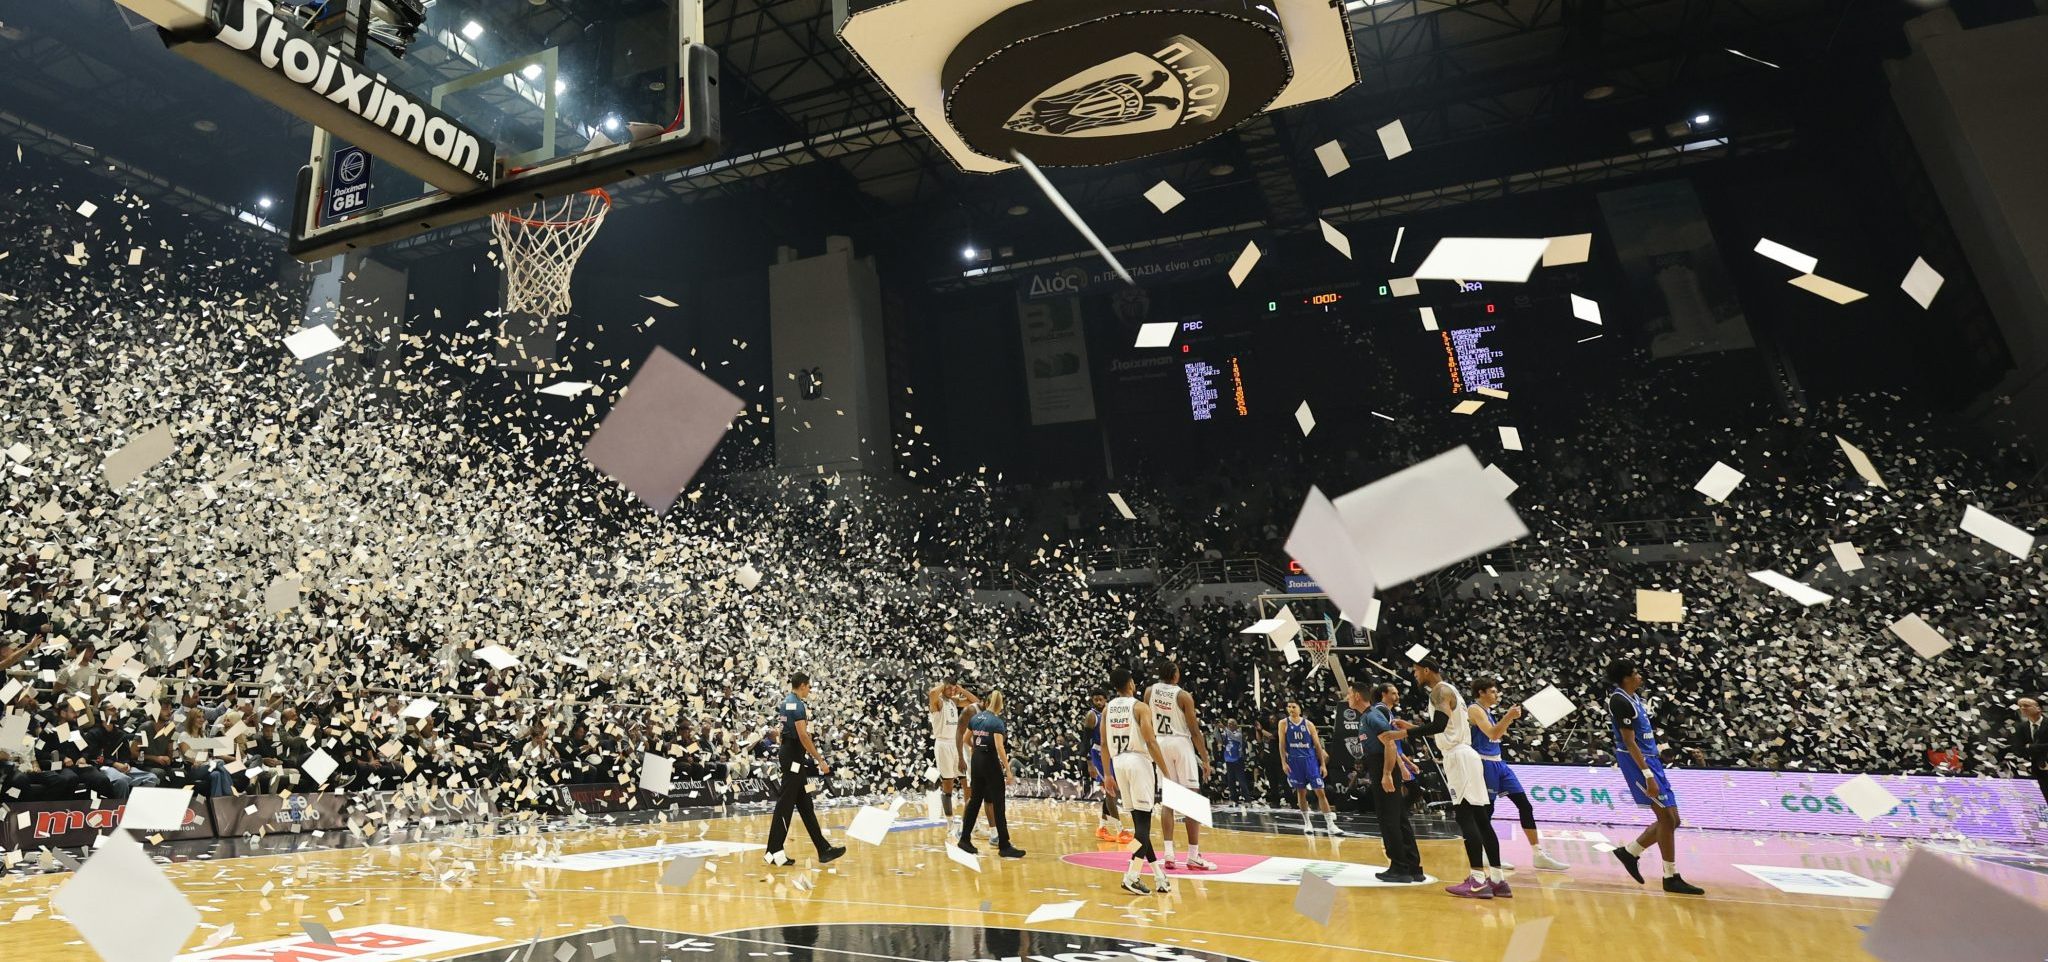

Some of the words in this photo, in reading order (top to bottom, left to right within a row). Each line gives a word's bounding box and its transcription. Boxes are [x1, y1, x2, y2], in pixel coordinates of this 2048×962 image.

[216, 0, 480, 174] Stoiximan
[476, 168, 489, 182] 21+
[332, 182, 368, 198] Stoiximan
[332, 191, 365, 212] GBL
[1183, 321, 1203, 331] PBC
[1294, 732, 1304, 740] 10
